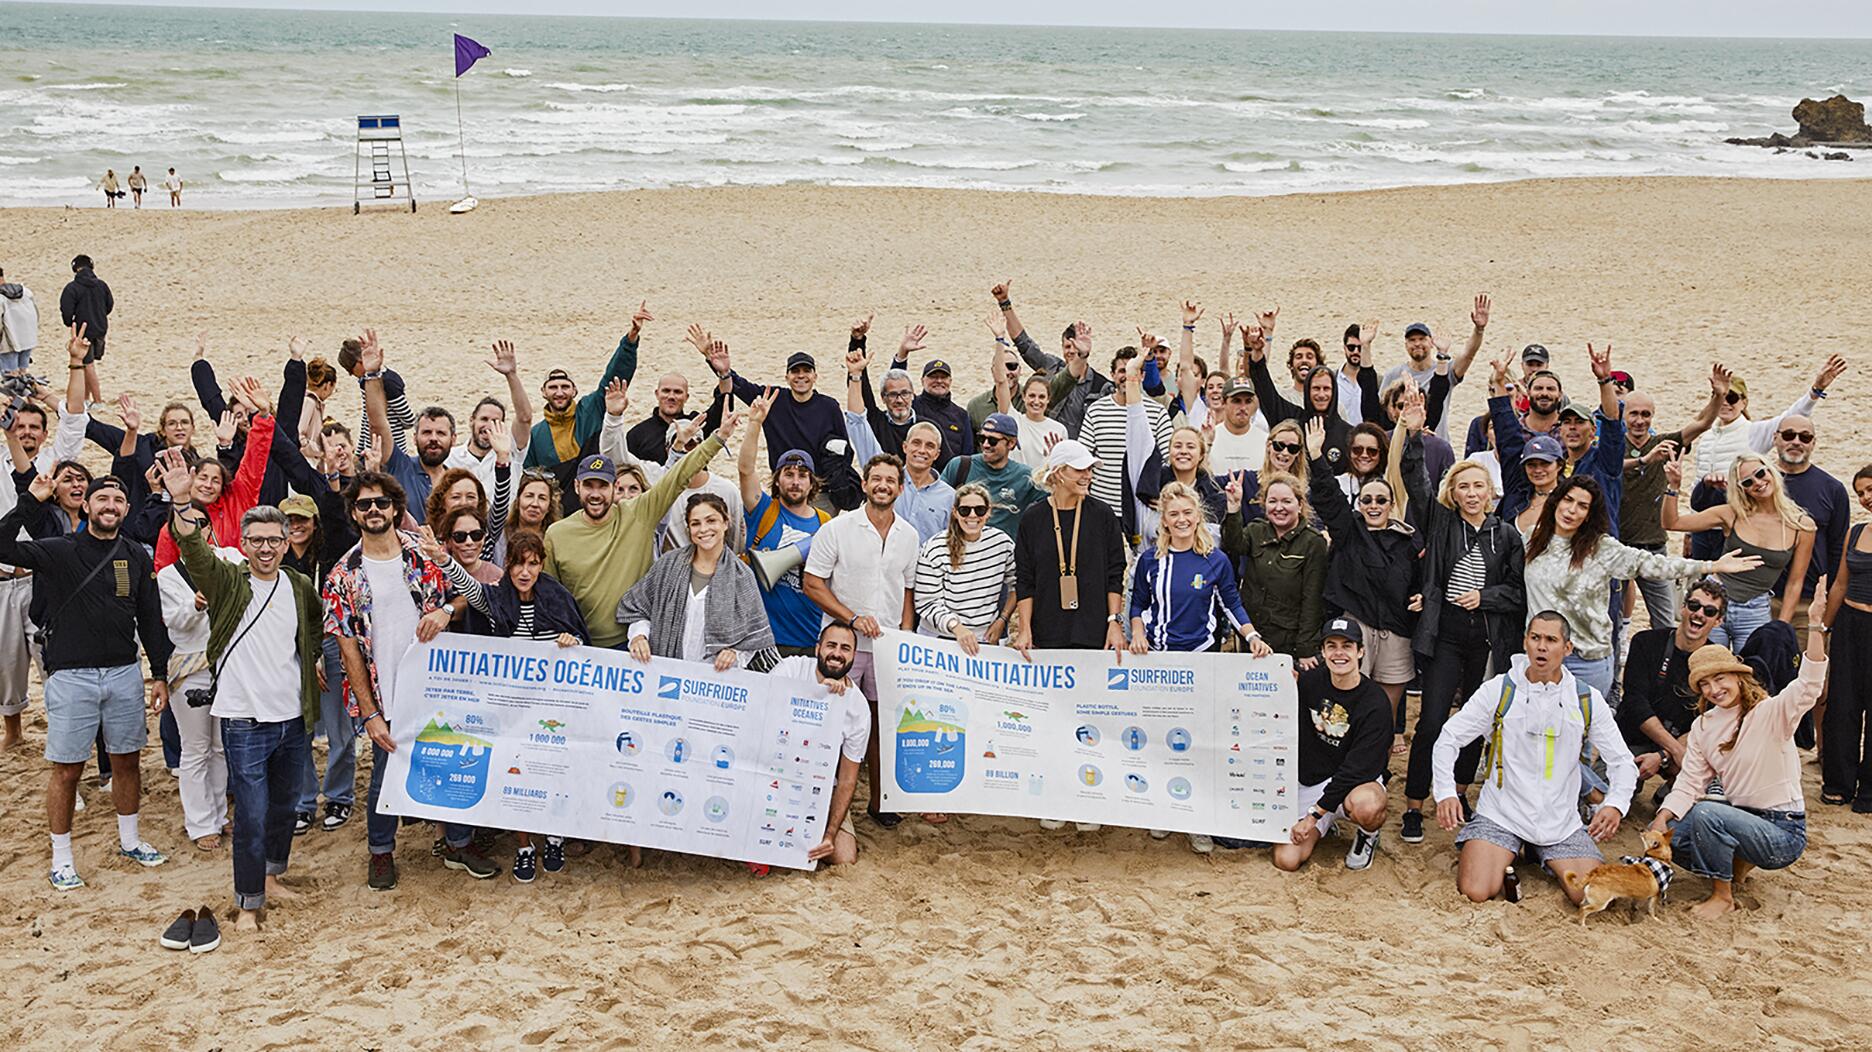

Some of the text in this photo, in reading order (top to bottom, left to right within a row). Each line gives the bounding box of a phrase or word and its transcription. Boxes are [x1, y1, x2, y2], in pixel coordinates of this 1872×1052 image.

[428, 648, 645, 694] INITIATIVES OCÉANES
[898, 642, 960, 673] OCEAN
[965, 657, 1076, 689] INITIATIVES
[1130, 668, 1194, 685] SURFRIDER
[1245, 671, 1268, 681] OCEAN
[682, 679, 748, 703] SURFRIDER
[1238, 682, 1278, 692] INITIATIVES
[720, 702, 746, 711] EUROPE
[790, 697, 829, 711] INITIATIVES
[939, 704, 955, 714] 80%
[621, 708, 650, 717] BOUTEILLE
[465, 714, 484, 725] 80%
[653, 718, 677, 727] SIMPLES
[535, 733, 550, 743] 000
[551, 735, 566, 745] 000
[427, 747, 440, 756] 000
[440, 749, 454, 758] 000
[463, 774, 476, 784] 000
[995, 770, 1019, 779] BILLION
[512, 787, 548, 799] MILLIARDS
